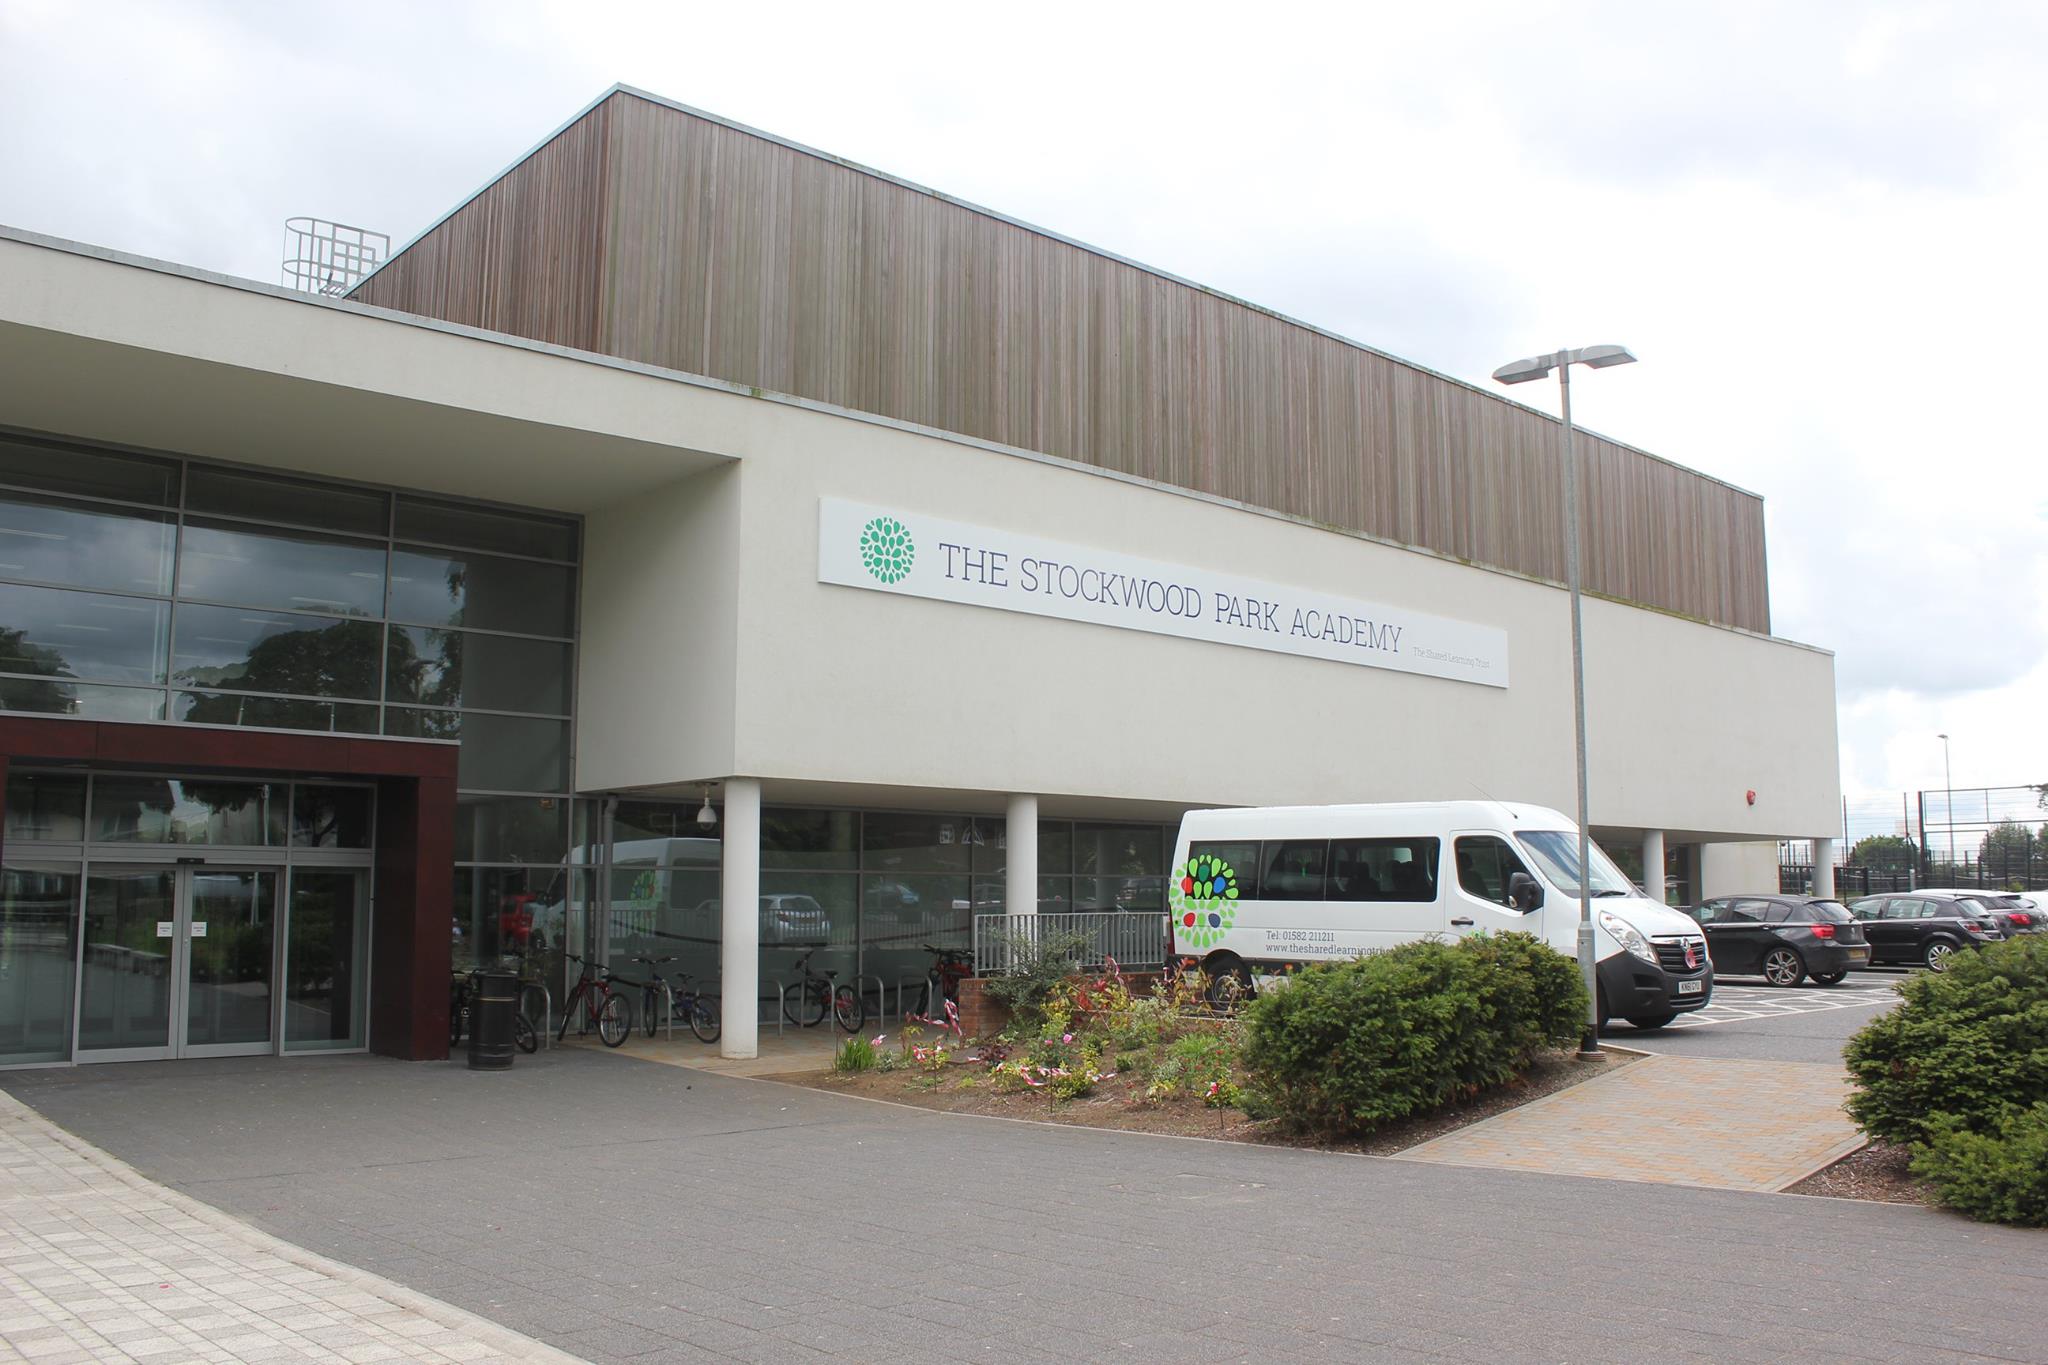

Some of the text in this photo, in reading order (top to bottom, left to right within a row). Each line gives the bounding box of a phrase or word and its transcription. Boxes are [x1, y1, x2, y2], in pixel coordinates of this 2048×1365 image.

[939, 543, 1402, 653] THE STOCKWOOD PARK ACADEMY
[1412, 646, 1425, 657] The
[1266, 930, 1334, 942] Tel: 01582 211211
